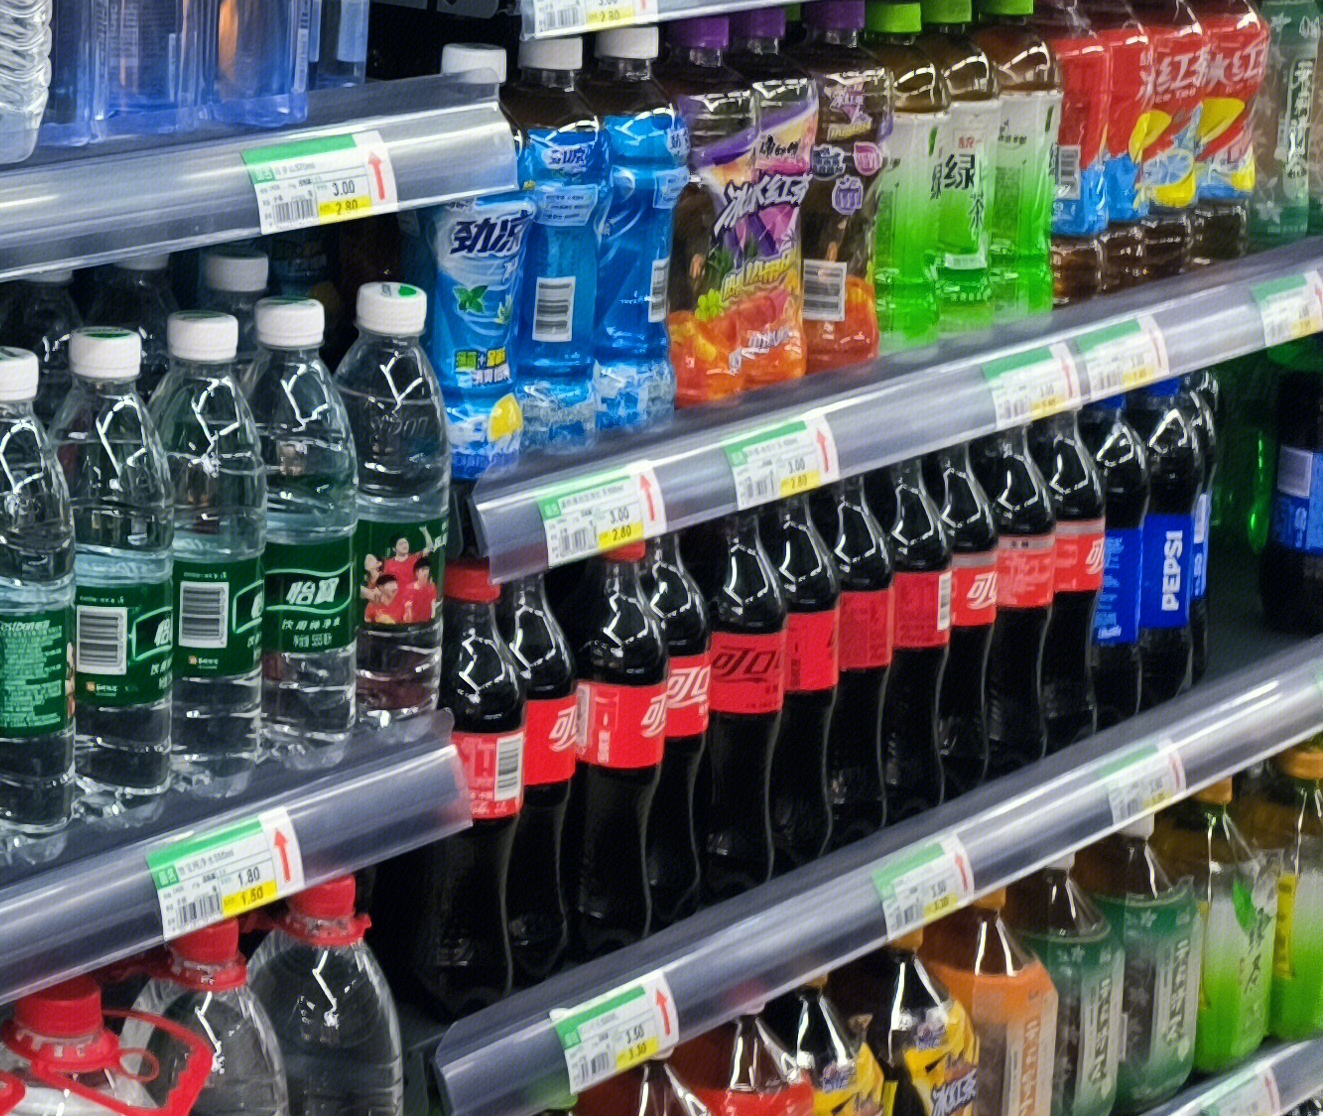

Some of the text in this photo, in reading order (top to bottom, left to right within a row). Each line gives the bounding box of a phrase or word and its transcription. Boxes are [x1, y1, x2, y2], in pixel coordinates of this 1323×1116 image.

[332, 180, 355, 196] 3.00
[612, 525, 632, 541] 2.80
[1161, 530, 1183, 611] PEPSI
